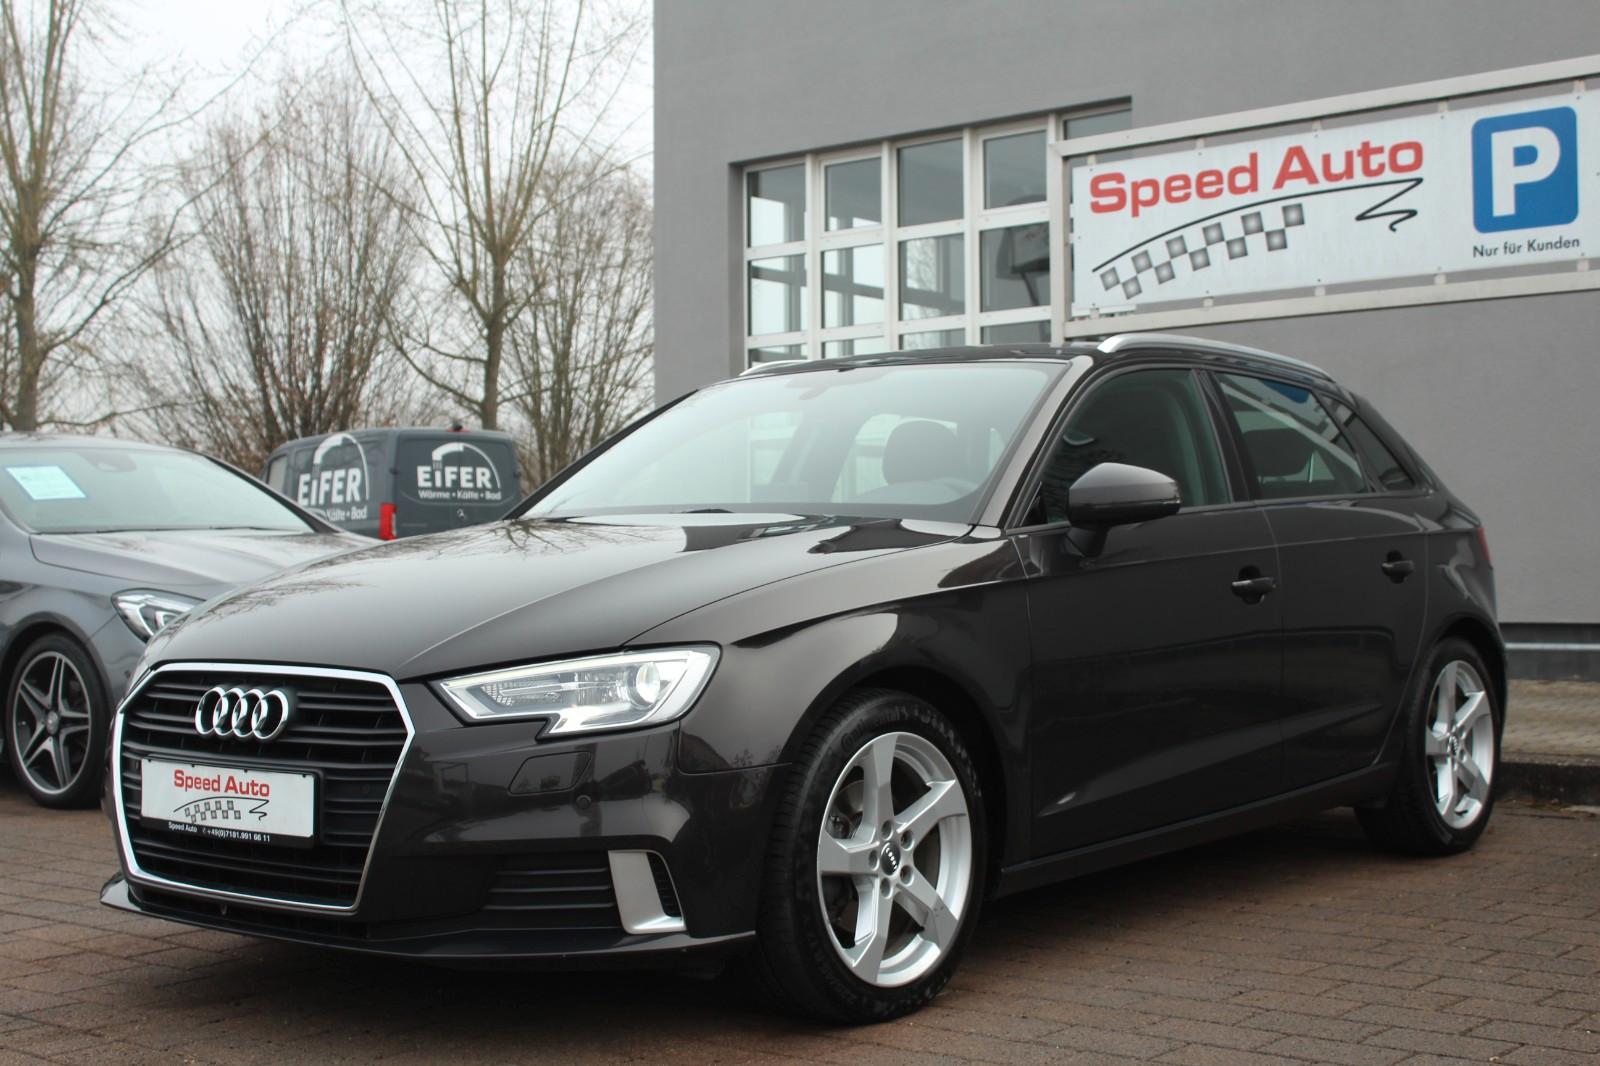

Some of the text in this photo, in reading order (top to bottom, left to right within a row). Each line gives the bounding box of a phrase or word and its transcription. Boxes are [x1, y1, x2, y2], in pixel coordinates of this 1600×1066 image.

[1089, 139, 1424, 218] Speed Auto
[1490, 125, 1561, 218] P
[1473, 235, 1580, 258] Nur für Kunden
[418, 489, 502, 500] Wärme Kälte Bad
[351, 505, 367, 520] Bad
[174, 769, 269, 796] Speed Auto
[168, 821, 185, 831] Speed
[185, 824, 198, 833] Auto
[263, 834, 270, 842] 11
